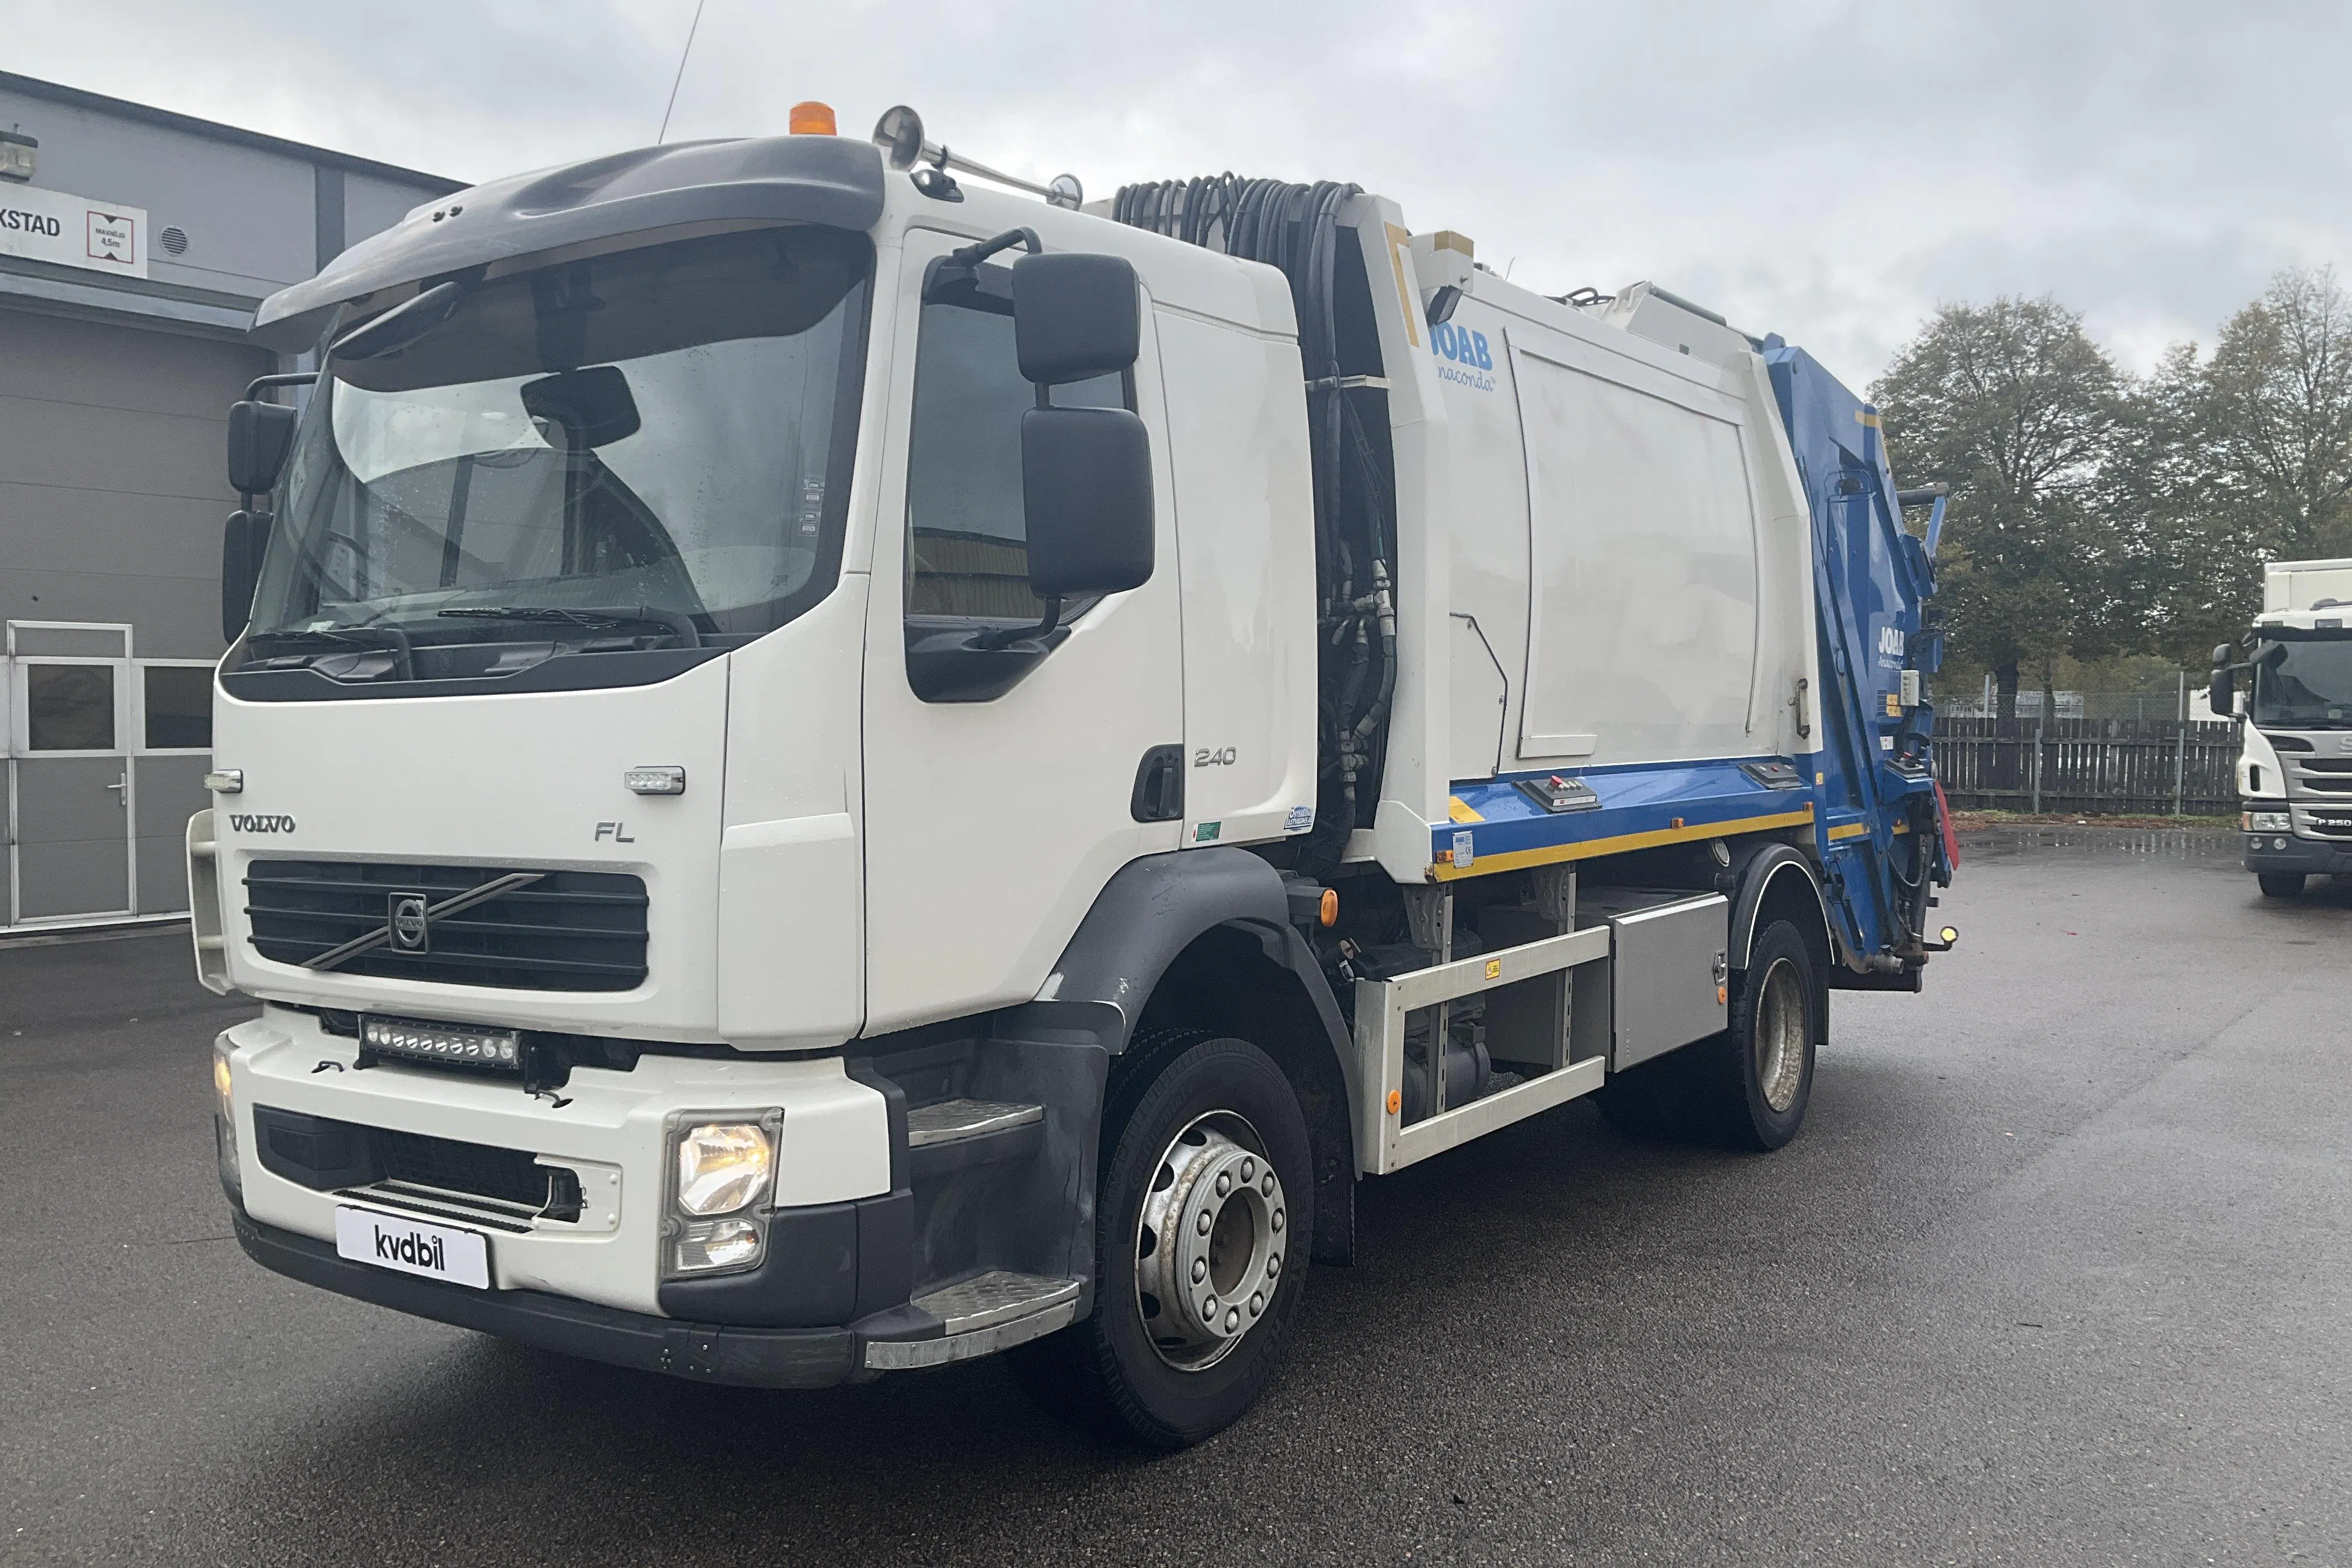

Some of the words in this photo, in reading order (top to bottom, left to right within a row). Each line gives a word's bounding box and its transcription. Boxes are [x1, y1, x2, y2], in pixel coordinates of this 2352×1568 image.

[1878, 626, 1905, 656] JOAB
[1194, 747, 1236, 766] 240
[229, 814, 296, 833] VOLVO
[595, 821, 635, 842] FL
[374, 1224, 445, 1271] kvdbil
